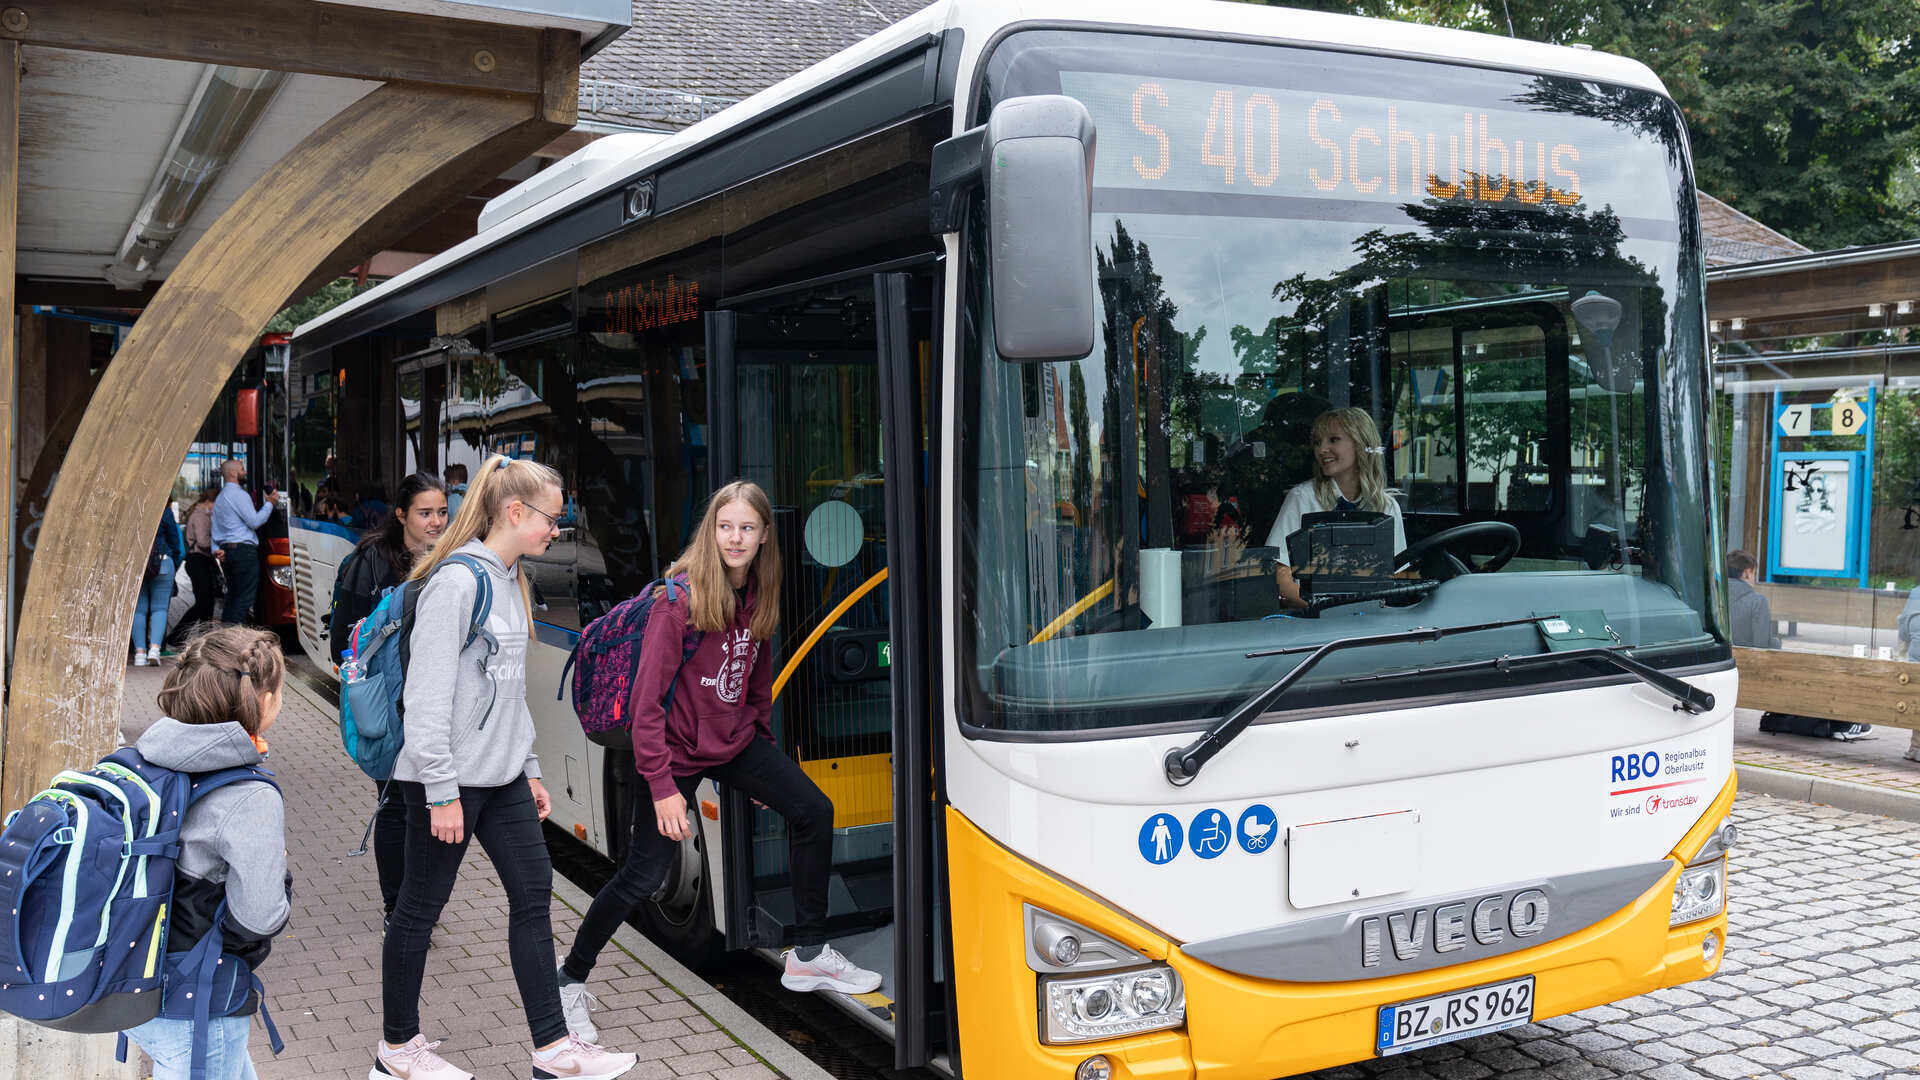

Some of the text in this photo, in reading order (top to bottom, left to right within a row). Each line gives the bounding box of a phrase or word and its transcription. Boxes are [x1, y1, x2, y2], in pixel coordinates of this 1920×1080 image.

[1130, 80, 1584, 208] S 40 Schulbus
[1790, 411, 1802, 429] 7
[1841, 408, 1854, 428] 8
[1664, 747, 1707, 763] Regionalbus
[1611, 750, 1660, 783] RBO
[1664, 761, 1705, 775] Oberlausitz
[1610, 794, 1698, 818] Wir sind transdev
[1361, 888, 1550, 968] IVECO
[1396, 984, 1530, 1041] BZ RS 962
[1383, 1032, 1390, 1042] D
